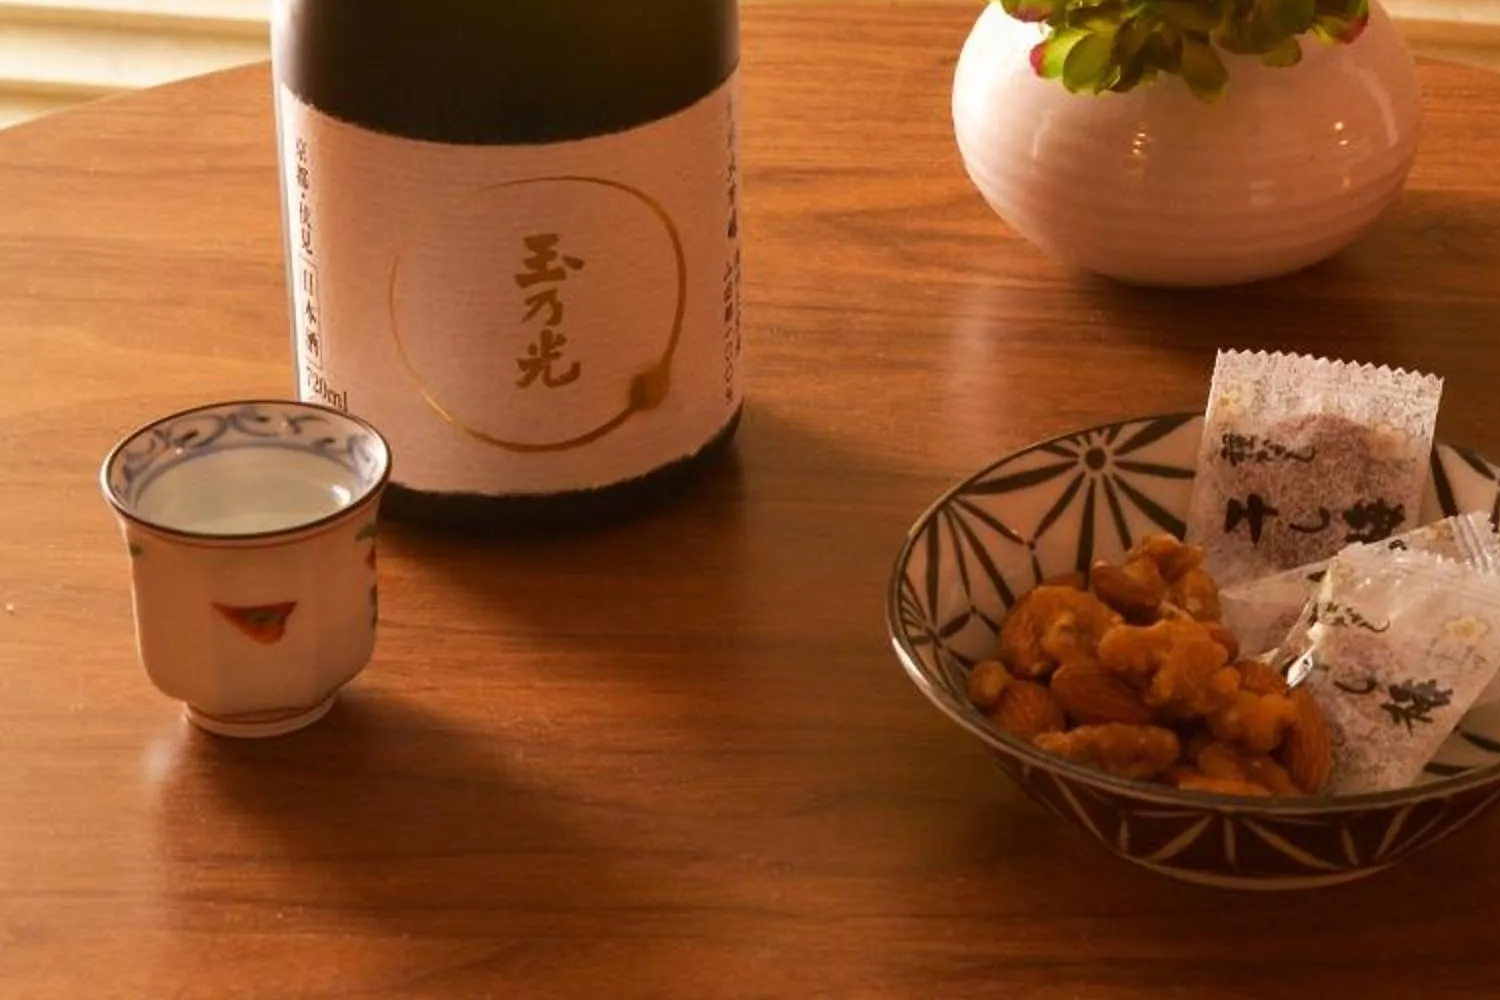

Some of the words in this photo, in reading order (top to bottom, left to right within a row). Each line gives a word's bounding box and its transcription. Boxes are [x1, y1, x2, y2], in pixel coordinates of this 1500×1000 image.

[514, 233, 585, 389] 玉乃光
[305, 365, 348, 413] 720ml
